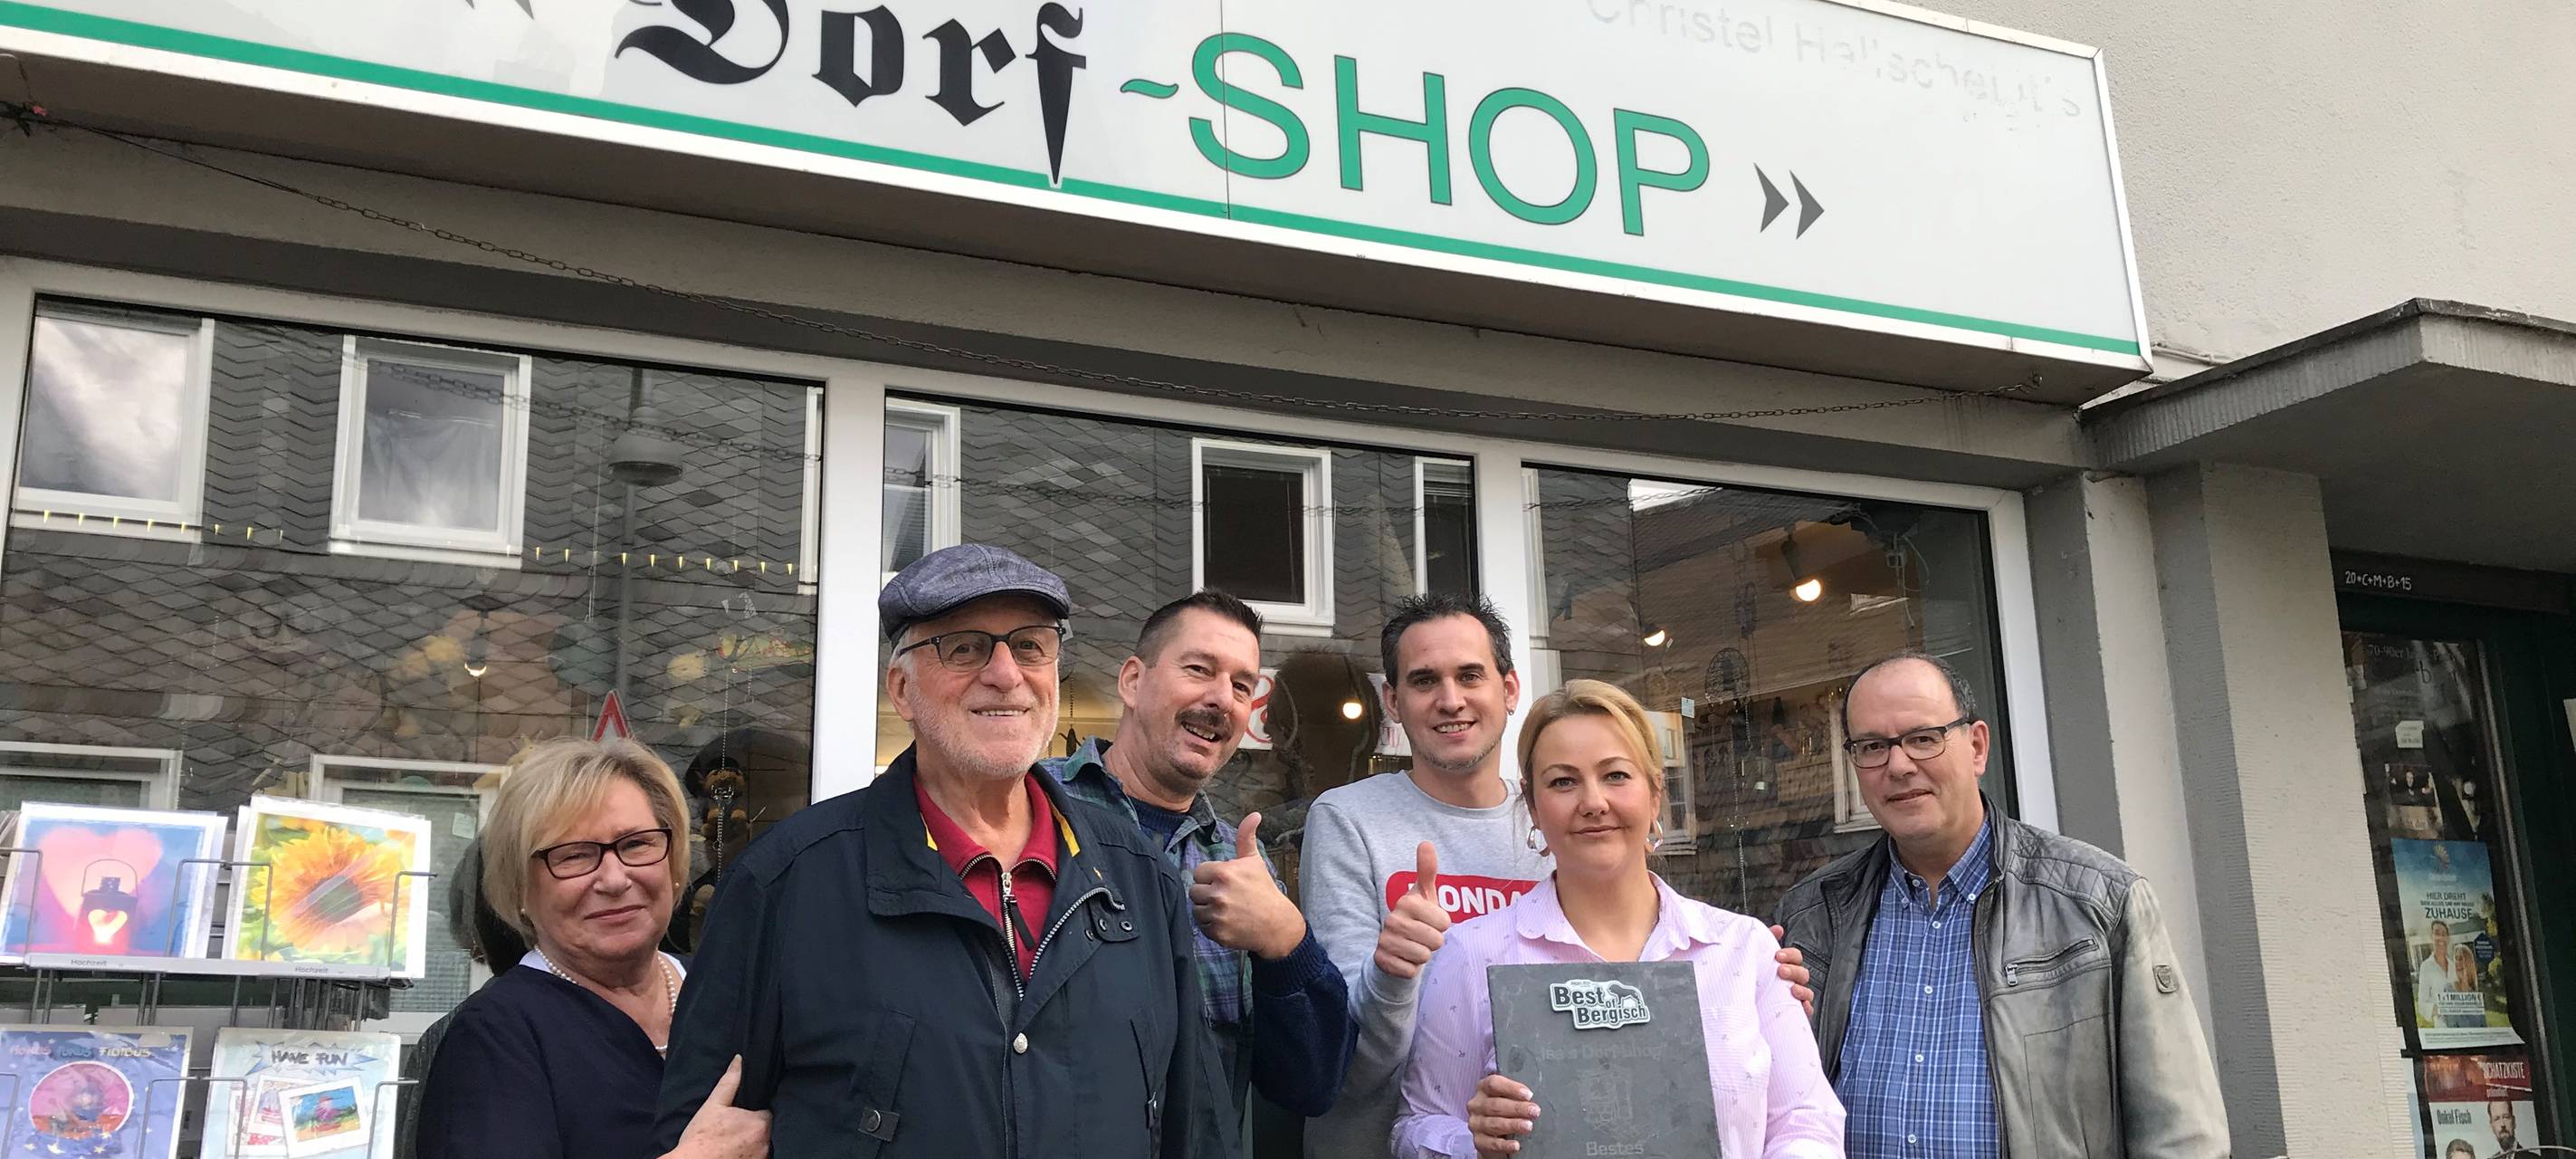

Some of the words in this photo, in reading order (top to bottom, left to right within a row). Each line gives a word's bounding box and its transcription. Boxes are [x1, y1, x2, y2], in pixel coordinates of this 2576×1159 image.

[2425, 907, 2473, 919] ZUHAUSE
[1554, 986, 1605, 1005] Best
[1606, 999, 1616, 1008] of
[1577, 1005, 1646, 1023] Bergisch
[272, 1050, 310, 1064] HAVE
[314, 1052, 348, 1065] FUN
[1586, 1141, 1645, 1156] Bestes
